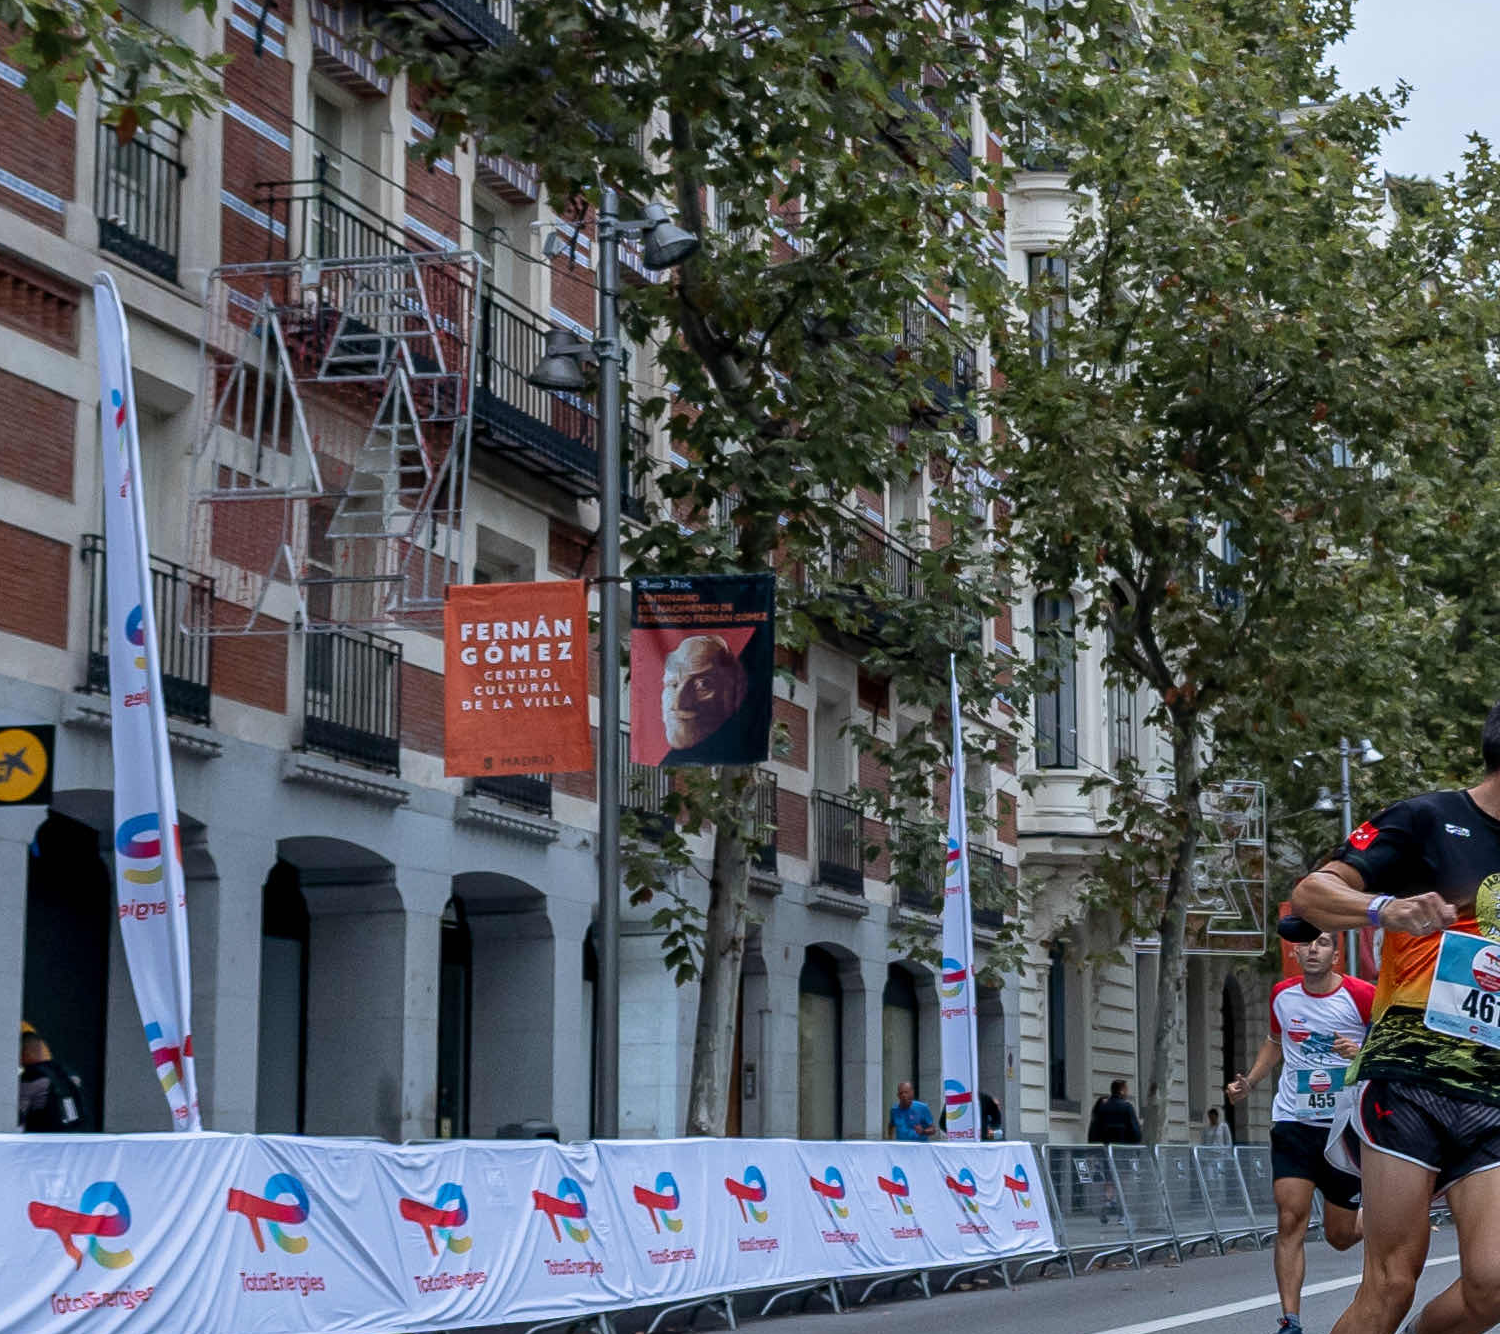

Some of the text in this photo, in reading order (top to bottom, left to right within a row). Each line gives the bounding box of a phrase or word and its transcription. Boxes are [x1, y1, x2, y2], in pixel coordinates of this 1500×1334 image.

[460, 615, 572, 642] FERNÁN
[460, 641, 572, 666] GÓMEZ
[484, 668, 551, 681] CENTRO
[473, 681, 562, 696] CULTURAL
[461, 695, 573, 711] DE LA VILLA
[1308, 1092, 1336, 1109] 455
[239, 1270, 327, 1297] TotalEnergies
